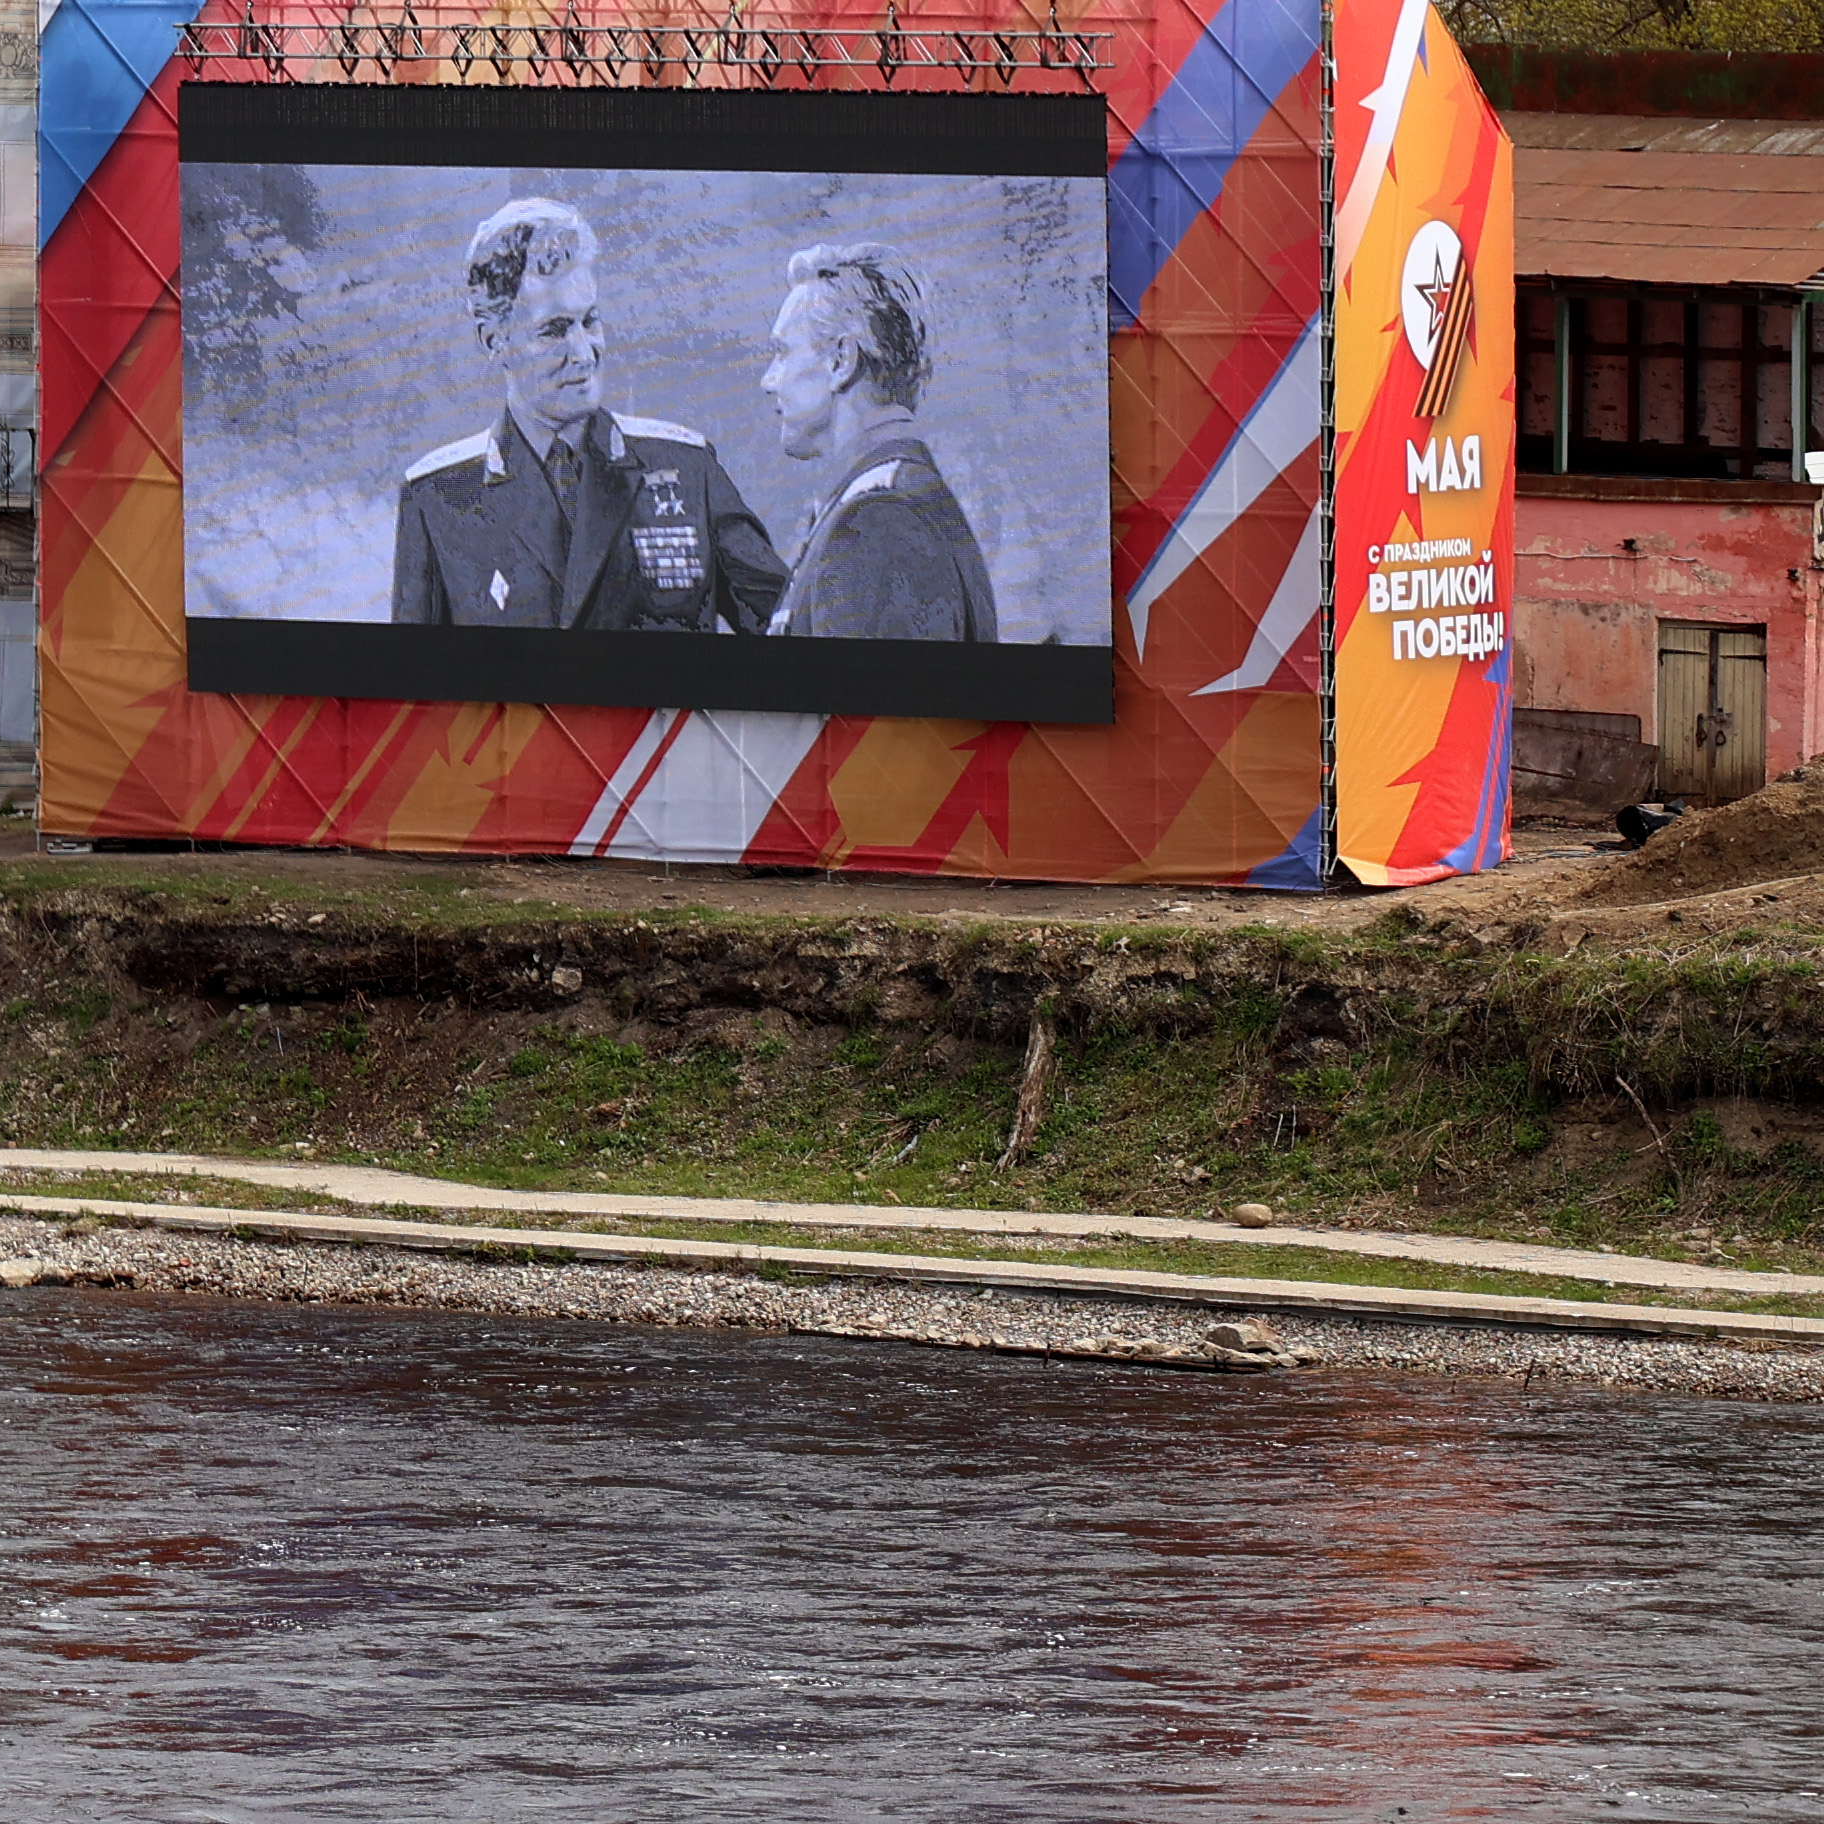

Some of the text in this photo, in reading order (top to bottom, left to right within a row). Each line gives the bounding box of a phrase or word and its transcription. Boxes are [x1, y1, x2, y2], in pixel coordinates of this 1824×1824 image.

[1406, 435, 1482, 494] МАЯ
[1368, 538, 1471, 563] С ПРАЗДНИКОМ
[1369, 550, 1494, 613] ВЕЛИКОЙ
[1392, 611, 1504, 661] ПОБЕДЫ!
